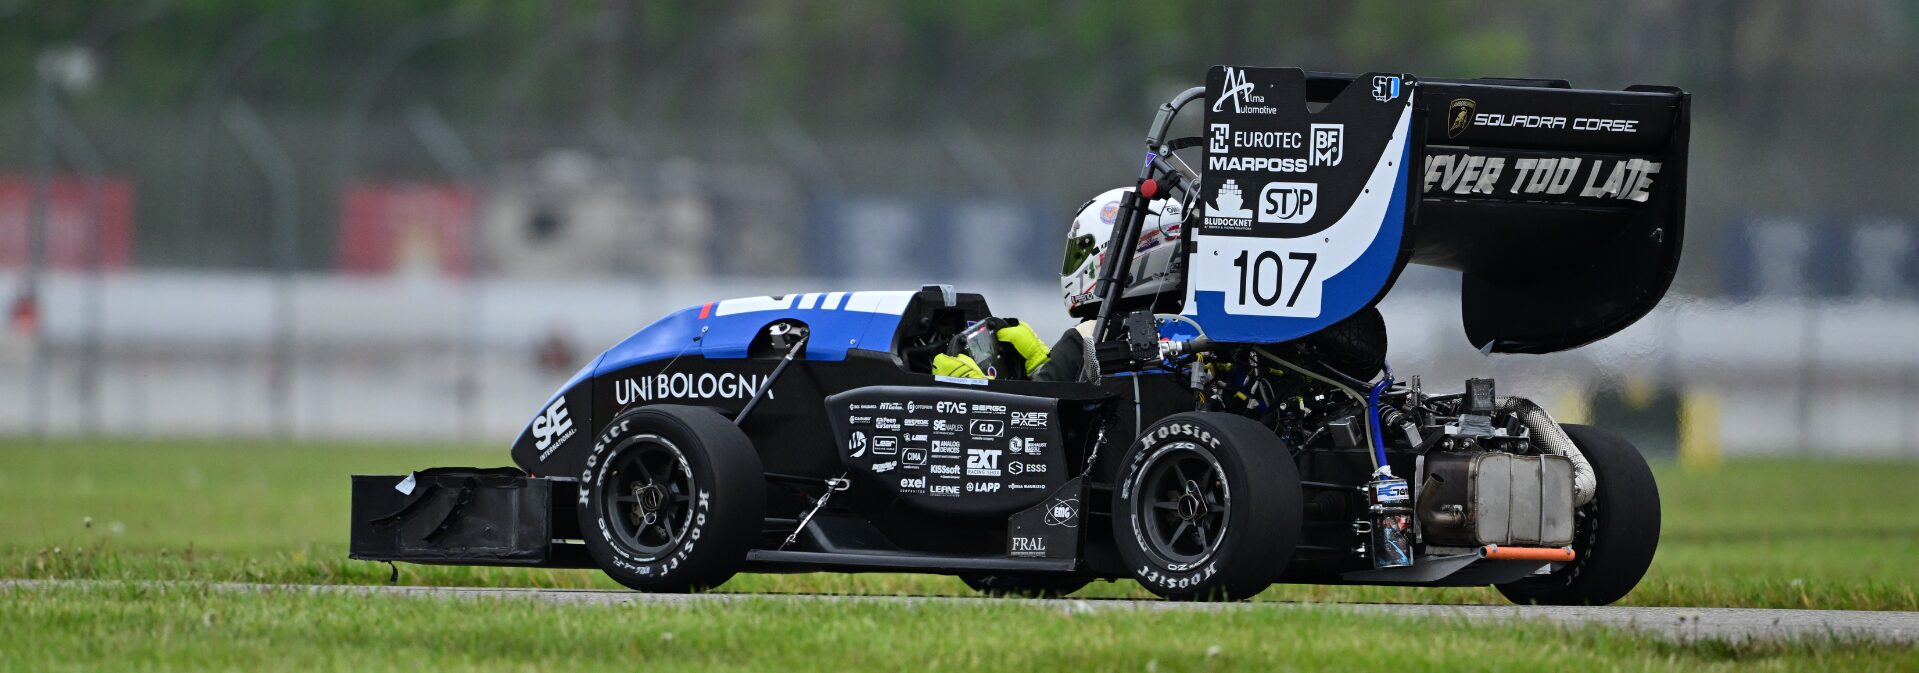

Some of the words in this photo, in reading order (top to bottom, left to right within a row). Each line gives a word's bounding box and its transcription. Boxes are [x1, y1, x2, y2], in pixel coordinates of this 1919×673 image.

[1474, 113, 1567, 129] SQUADRA
[1573, 117, 1639, 133] CORSE
[1234, 131, 1302, 149] EUROTEC
[1209, 157, 1307, 173] MARPOSS
[1510, 157, 1582, 195] TOO
[1579, 158, 1662, 203] LATE
[1204, 217, 1252, 227] BLUDOCKNET
[1233, 249, 1317, 308] 107
[615, 375, 652, 405] UNI
[532, 395, 573, 451] SAE
[1011, 411, 1048, 420] OVER
[1011, 418, 1047, 427] PACK
[1140, 423, 1221, 451] Hoosier
[907, 452, 921, 461] CIMA
[939, 446, 960, 454] DEVICES
[578, 419, 630, 509] Hoosier
[967, 448, 1002, 470] EXT
[930, 464, 960, 475] KISSsoft
[1026, 464, 1047, 473] ESSS
[900, 476, 926, 489] exel
[975, 482, 1001, 493] LAPP
[660, 489, 710, 577] Hoosier
[1011, 537, 1046, 551] FRAL
[1137, 560, 1218, 589] Hoosier
